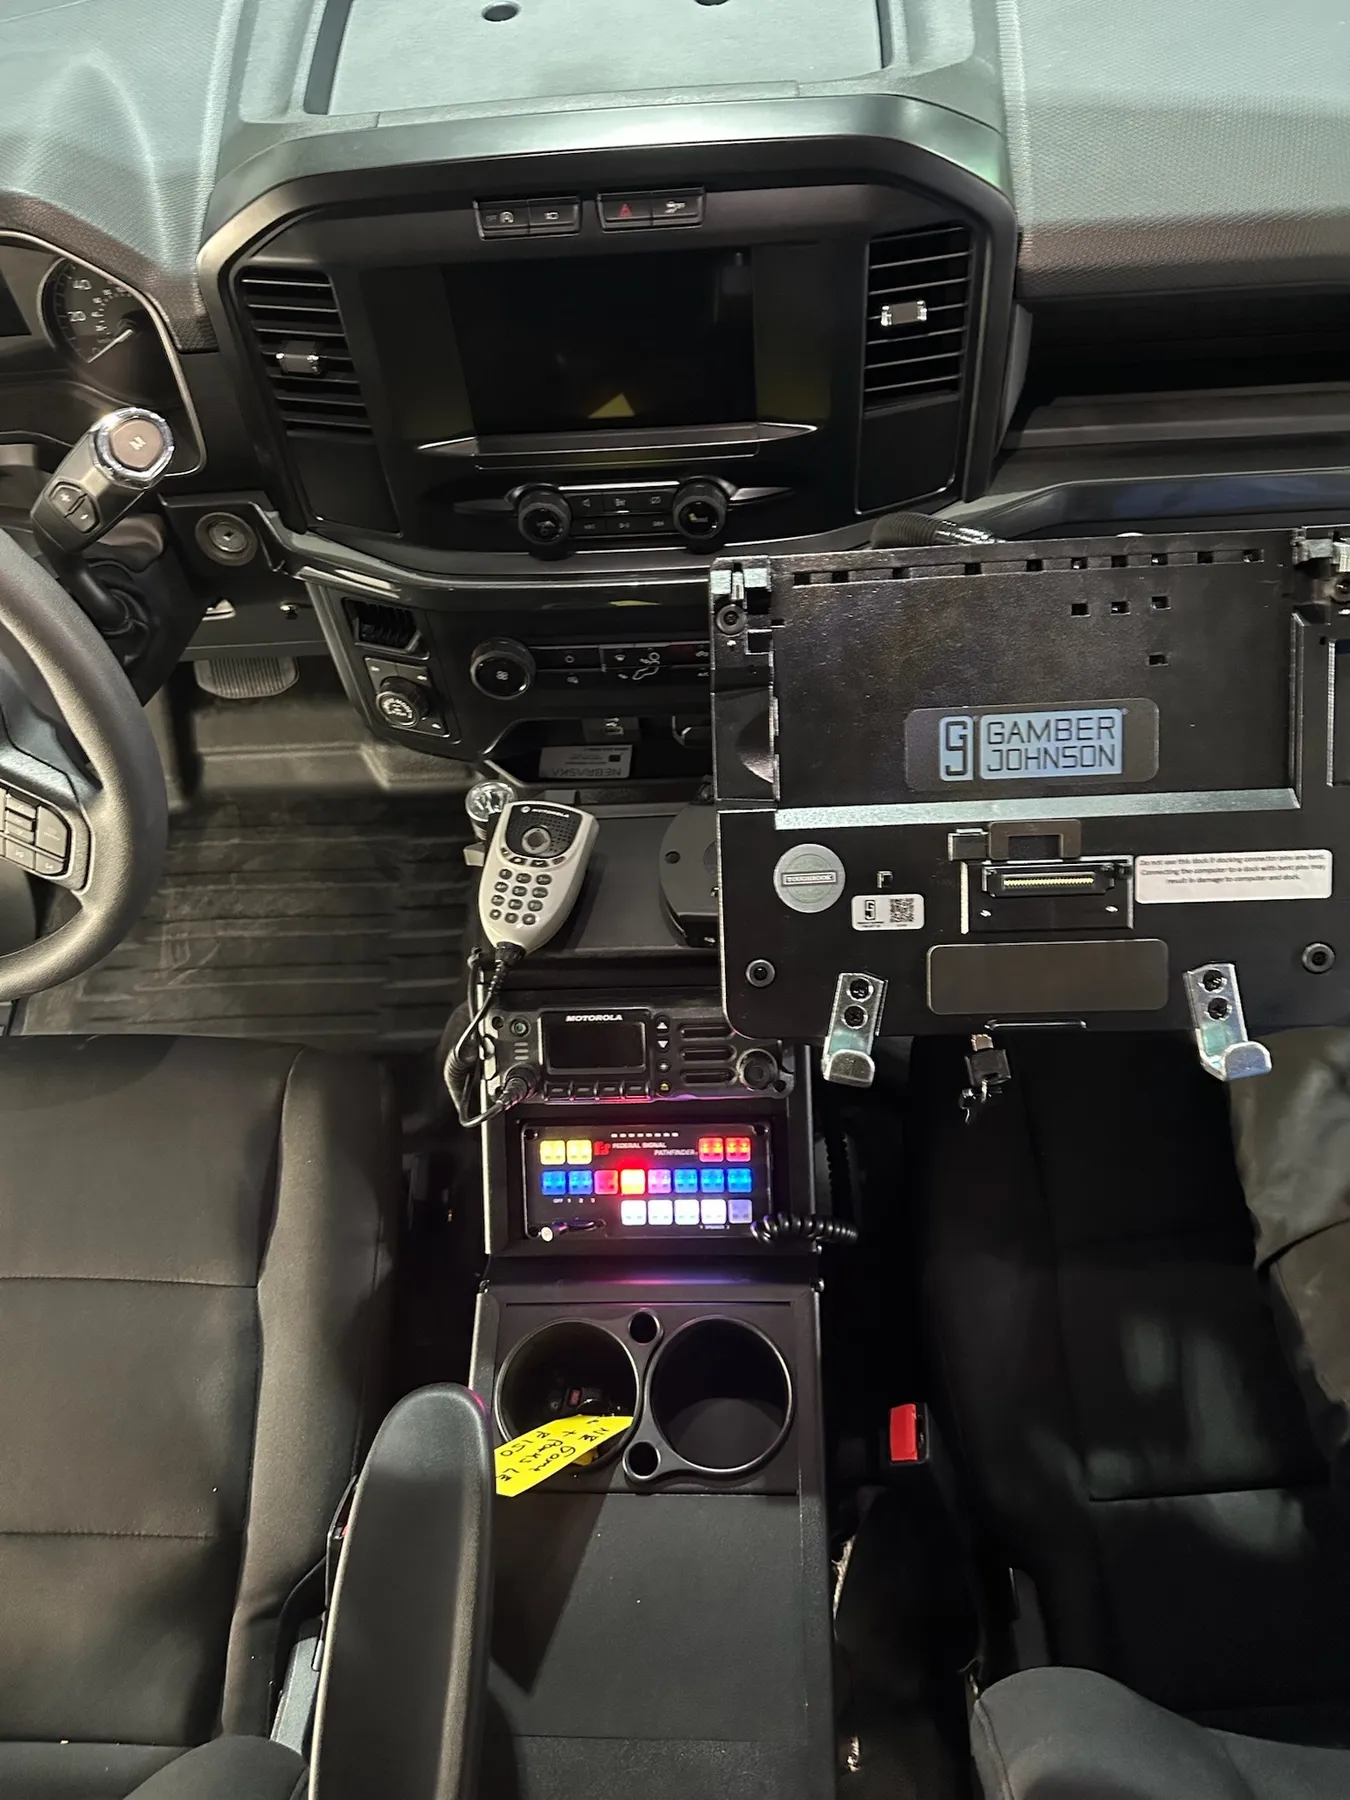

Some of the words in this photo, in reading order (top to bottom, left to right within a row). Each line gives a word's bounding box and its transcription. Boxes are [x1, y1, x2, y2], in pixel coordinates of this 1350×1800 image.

[986, 716, 1116, 744] GAMBER
[986, 744, 1116, 772] JOHNSON
[552, 768, 622, 776] NEBRASKA
[565, 1014, 623, 1022] MOTOROLA
